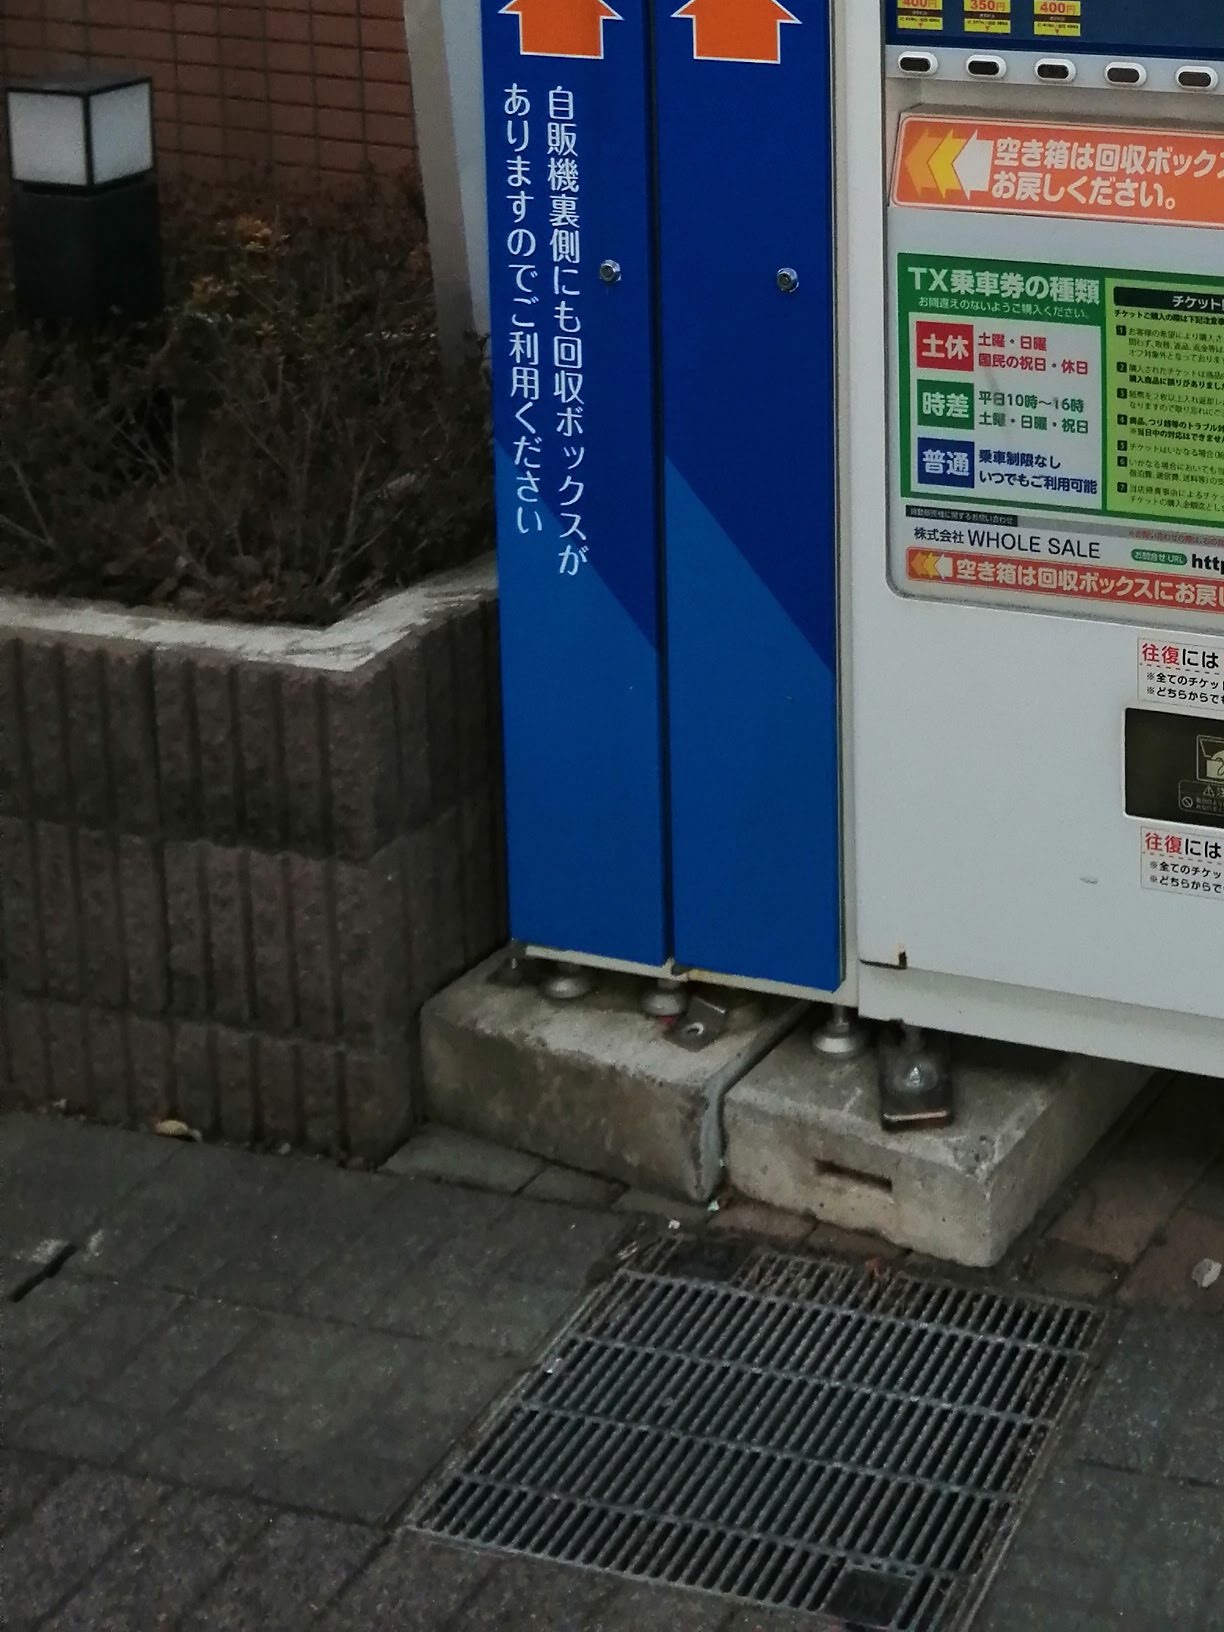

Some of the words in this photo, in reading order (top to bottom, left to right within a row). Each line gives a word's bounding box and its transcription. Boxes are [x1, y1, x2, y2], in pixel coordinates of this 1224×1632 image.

[1039, 2, 1077, 15] 400円
[992, 170, 1179, 212] お戻しください。
[906, 266, 1101, 306] TX乗車券の種類
[503, 82, 543, 535] ありますのでご利用ください
[546, 84, 590, 576] 自販機裏側にも回収ボックスが
[921, 332, 970, 360] 土休
[977, 331, 1048, 352] 土曜・日曜
[977, 352, 1089, 376] 国民の祝日・休日
[921, 391, 970, 418] 時差
[977, 412, 1089, 435] 土曜・日曜・祝日
[922, 449, 971, 477] 普通
[978, 448, 1062, 470] 乗車制限なし
[978, 470, 1099, 496] いつでもご利用可能
[913, 526, 965, 544] 株式会社
[967, 529, 1041, 553] WHOLE
[1048, 538, 1101, 559] SALE
